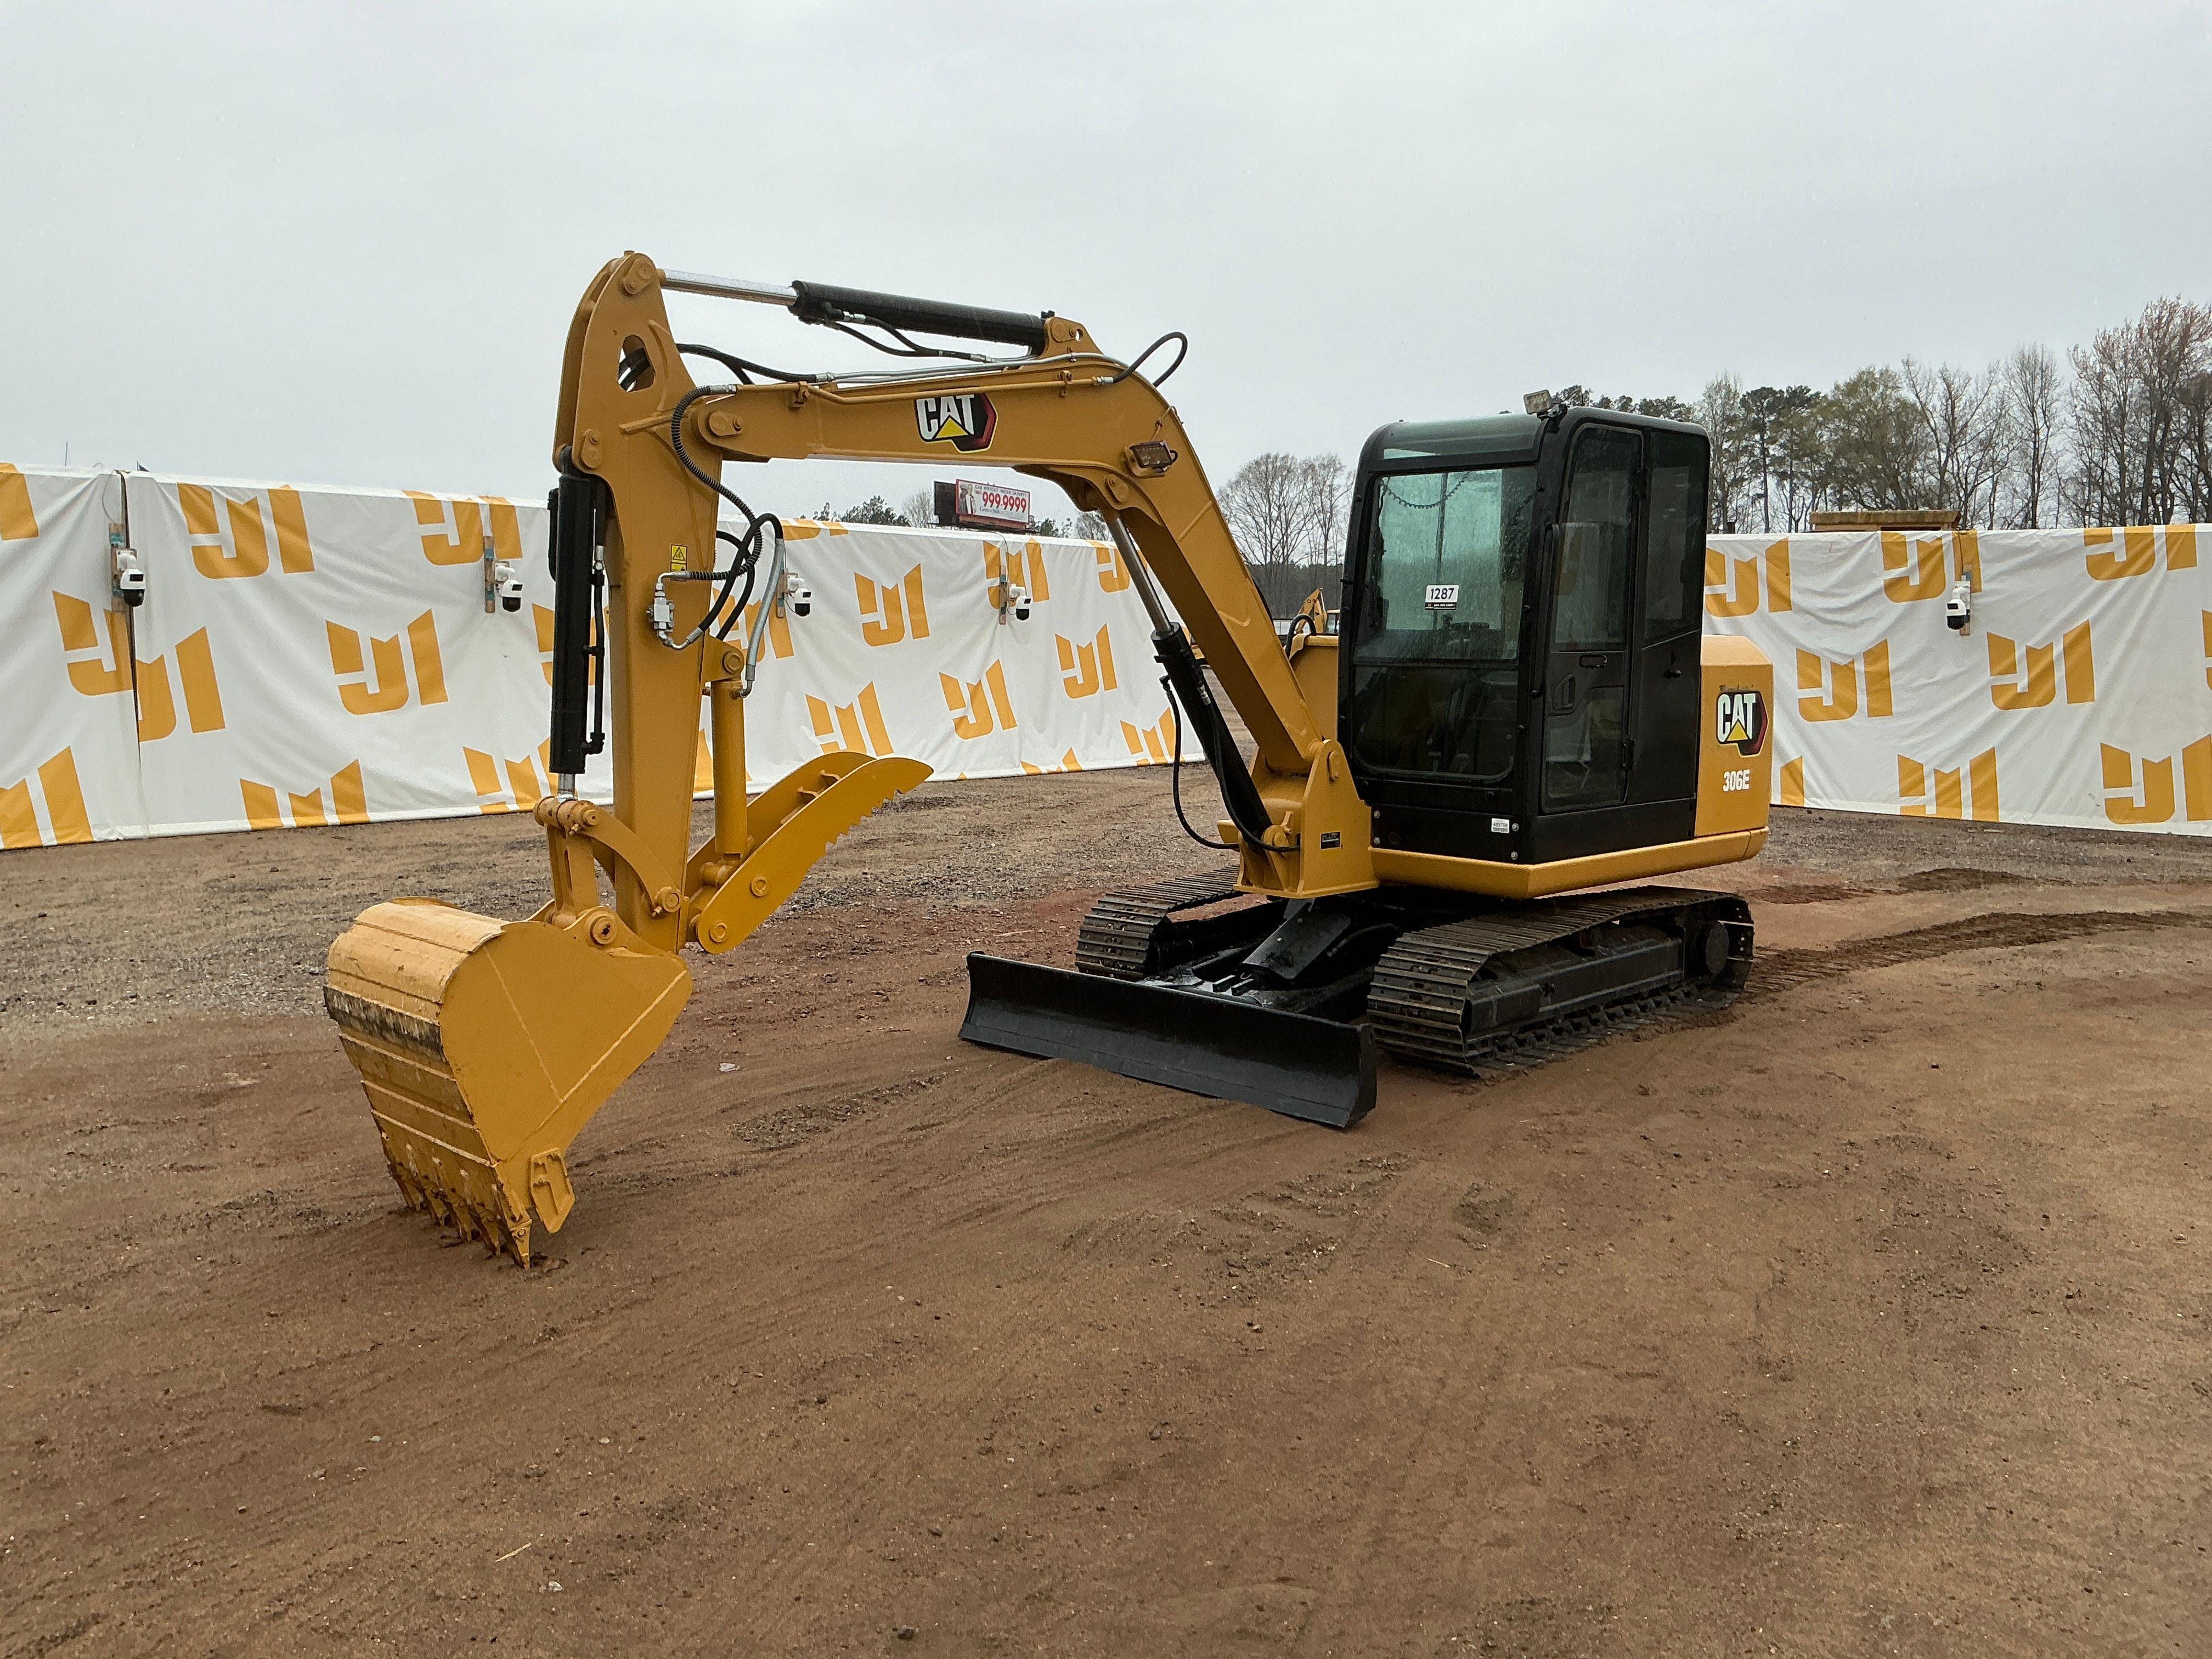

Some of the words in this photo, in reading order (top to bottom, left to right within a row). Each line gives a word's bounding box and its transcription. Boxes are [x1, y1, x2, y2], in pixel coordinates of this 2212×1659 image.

[916, 394, 975, 440] CAT
[1430, 588, 1454, 600] 1287
[1717, 693, 1756, 742] CAT
[1723, 769, 1750, 792] 306E
